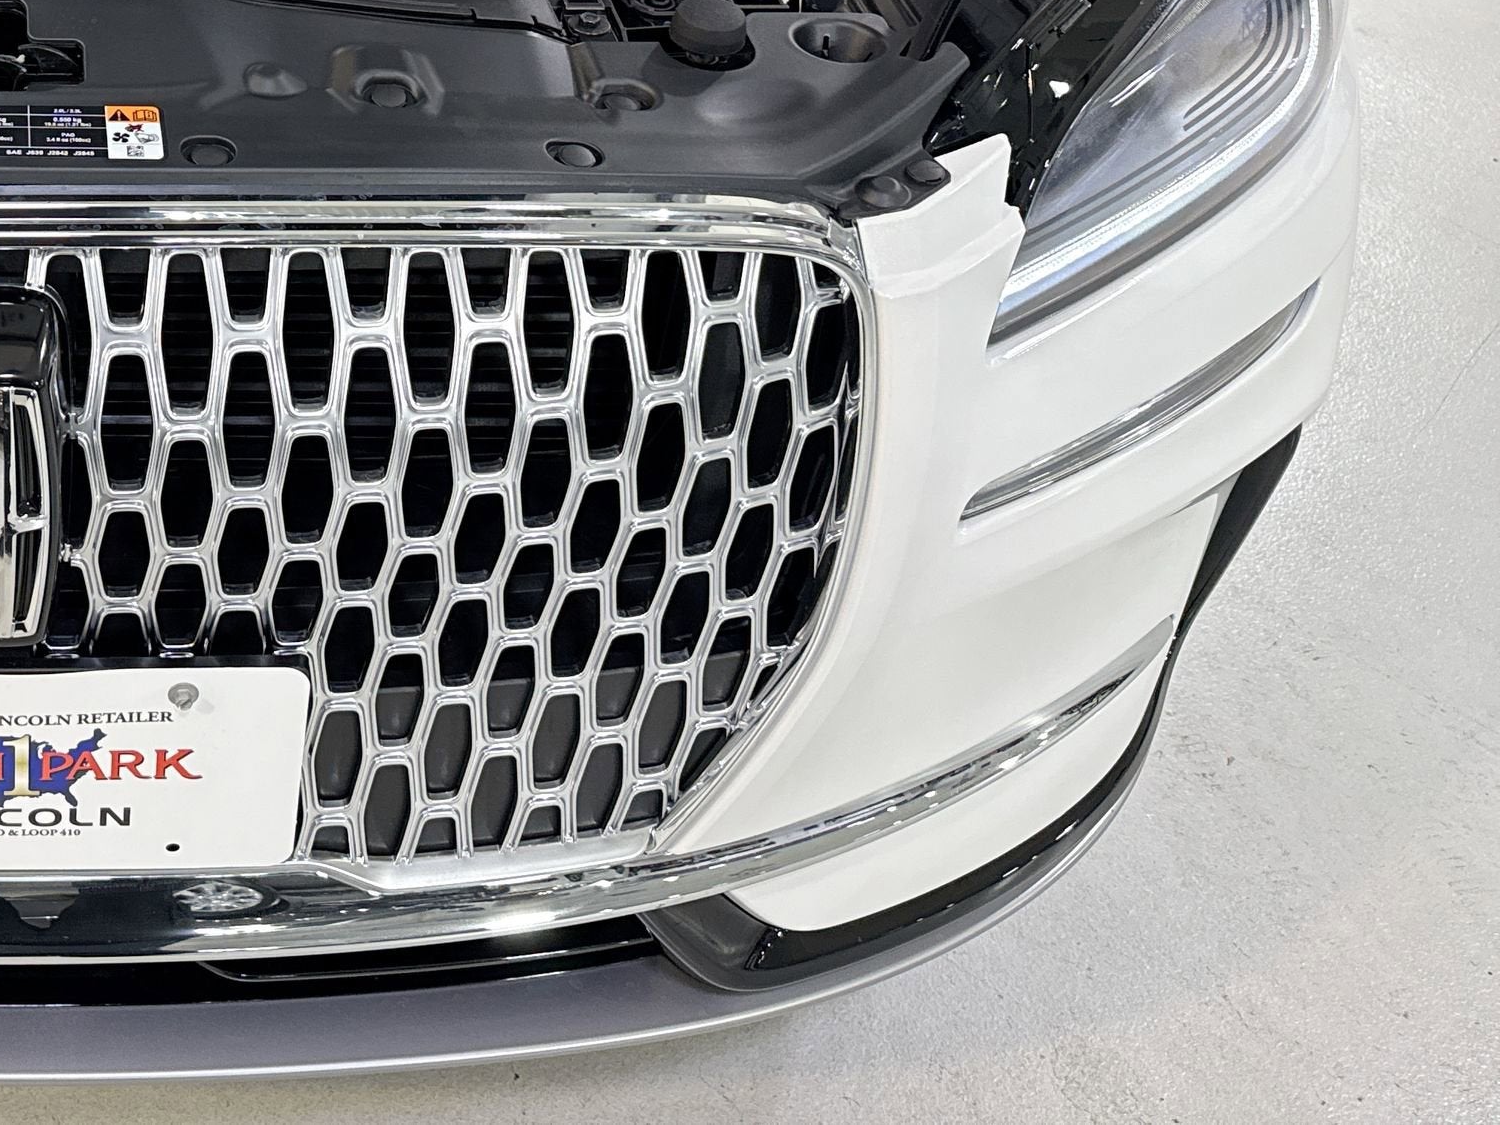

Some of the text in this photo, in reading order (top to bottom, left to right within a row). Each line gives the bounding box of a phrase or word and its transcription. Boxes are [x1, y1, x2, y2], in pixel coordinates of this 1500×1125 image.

[76, 710, 174, 725] RETAILER
[39, 748, 204, 781] PARK
[7, 828, 19, 837] &
[21, 827, 59, 837] LOOP
[59, 827, 82, 837] 410
